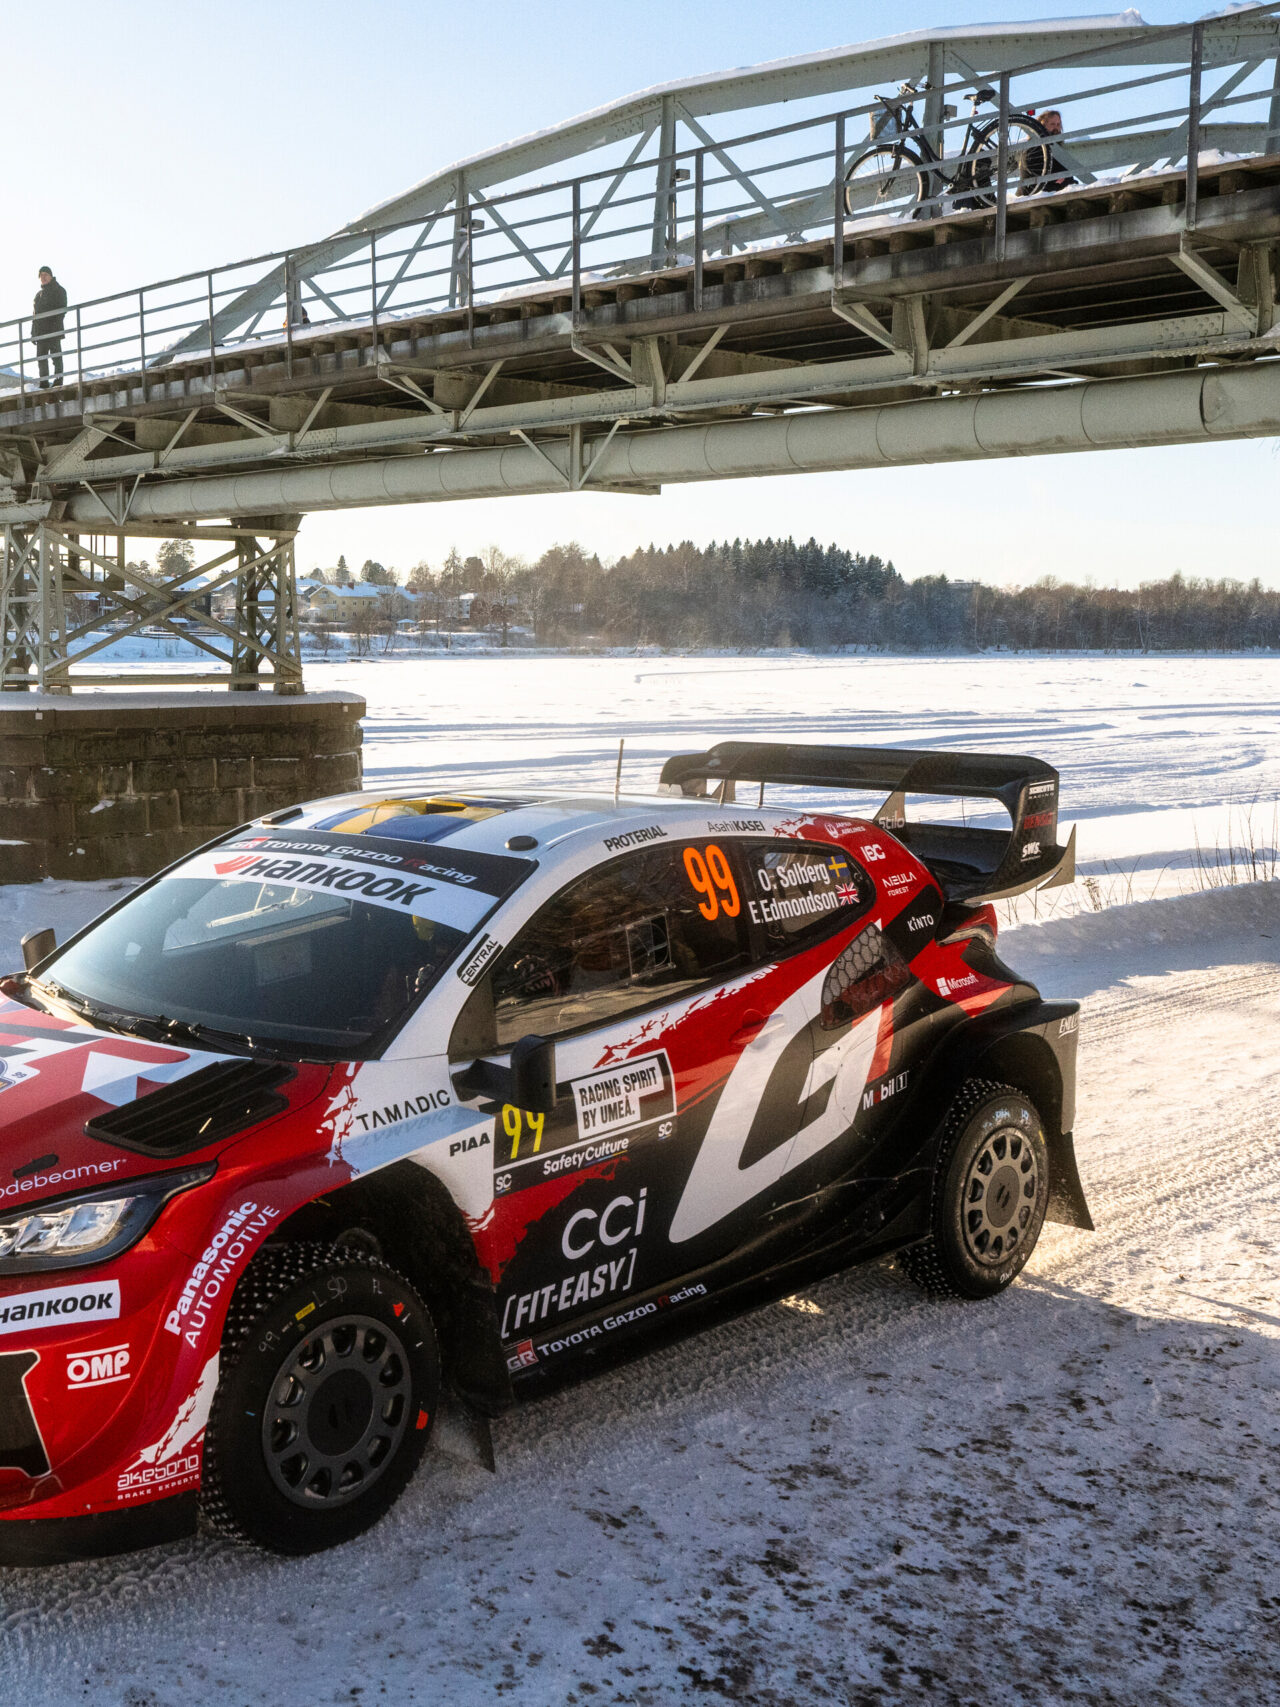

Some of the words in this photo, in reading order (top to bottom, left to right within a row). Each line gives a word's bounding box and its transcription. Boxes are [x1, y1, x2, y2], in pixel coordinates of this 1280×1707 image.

[603, 824, 668, 852] PROTERIAL
[707, 819, 766, 833] AsahiKASEI
[841, 825, 866, 835] AIRLINES
[261, 840, 331, 852] TOYOTA
[331, 846, 404, 864] GAZOO
[403, 858, 478, 884] Racing
[777, 862, 830, 889] Solberg
[683, 844, 741, 921] 99
[882, 871, 918, 888] NEULA
[887, 886, 909, 897] FOREST
[461, 939, 499, 984] CENTRAL
[947, 973, 979, 990] Microsoft
[579, 1077, 621, 1108] RACING
[623, 1066, 658, 1094] SPIRIT
[357, 1089, 451, 1131] TAMADIC
[582, 1108, 599, 1131] BY
[658, 1121, 673, 1138] SC
[449, 1132, 491, 1157] PIAA
[495, 1173, 513, 1191] SC
[164, 1201, 258, 1336] Panasonic
[184, 1205, 280, 1348] AUTOMOTIVE
[506, 1350, 539, 1371] GR
[537, 1325, 603, 1356] TOYOTA
[603, 1302, 658, 1330] GAZOO
[657, 1282, 708, 1308] Racing
[67, 1350, 130, 1383] OMP
[117, 1488, 152, 1500] BRAKE
[158, 1474, 200, 1491] EXPERTS
